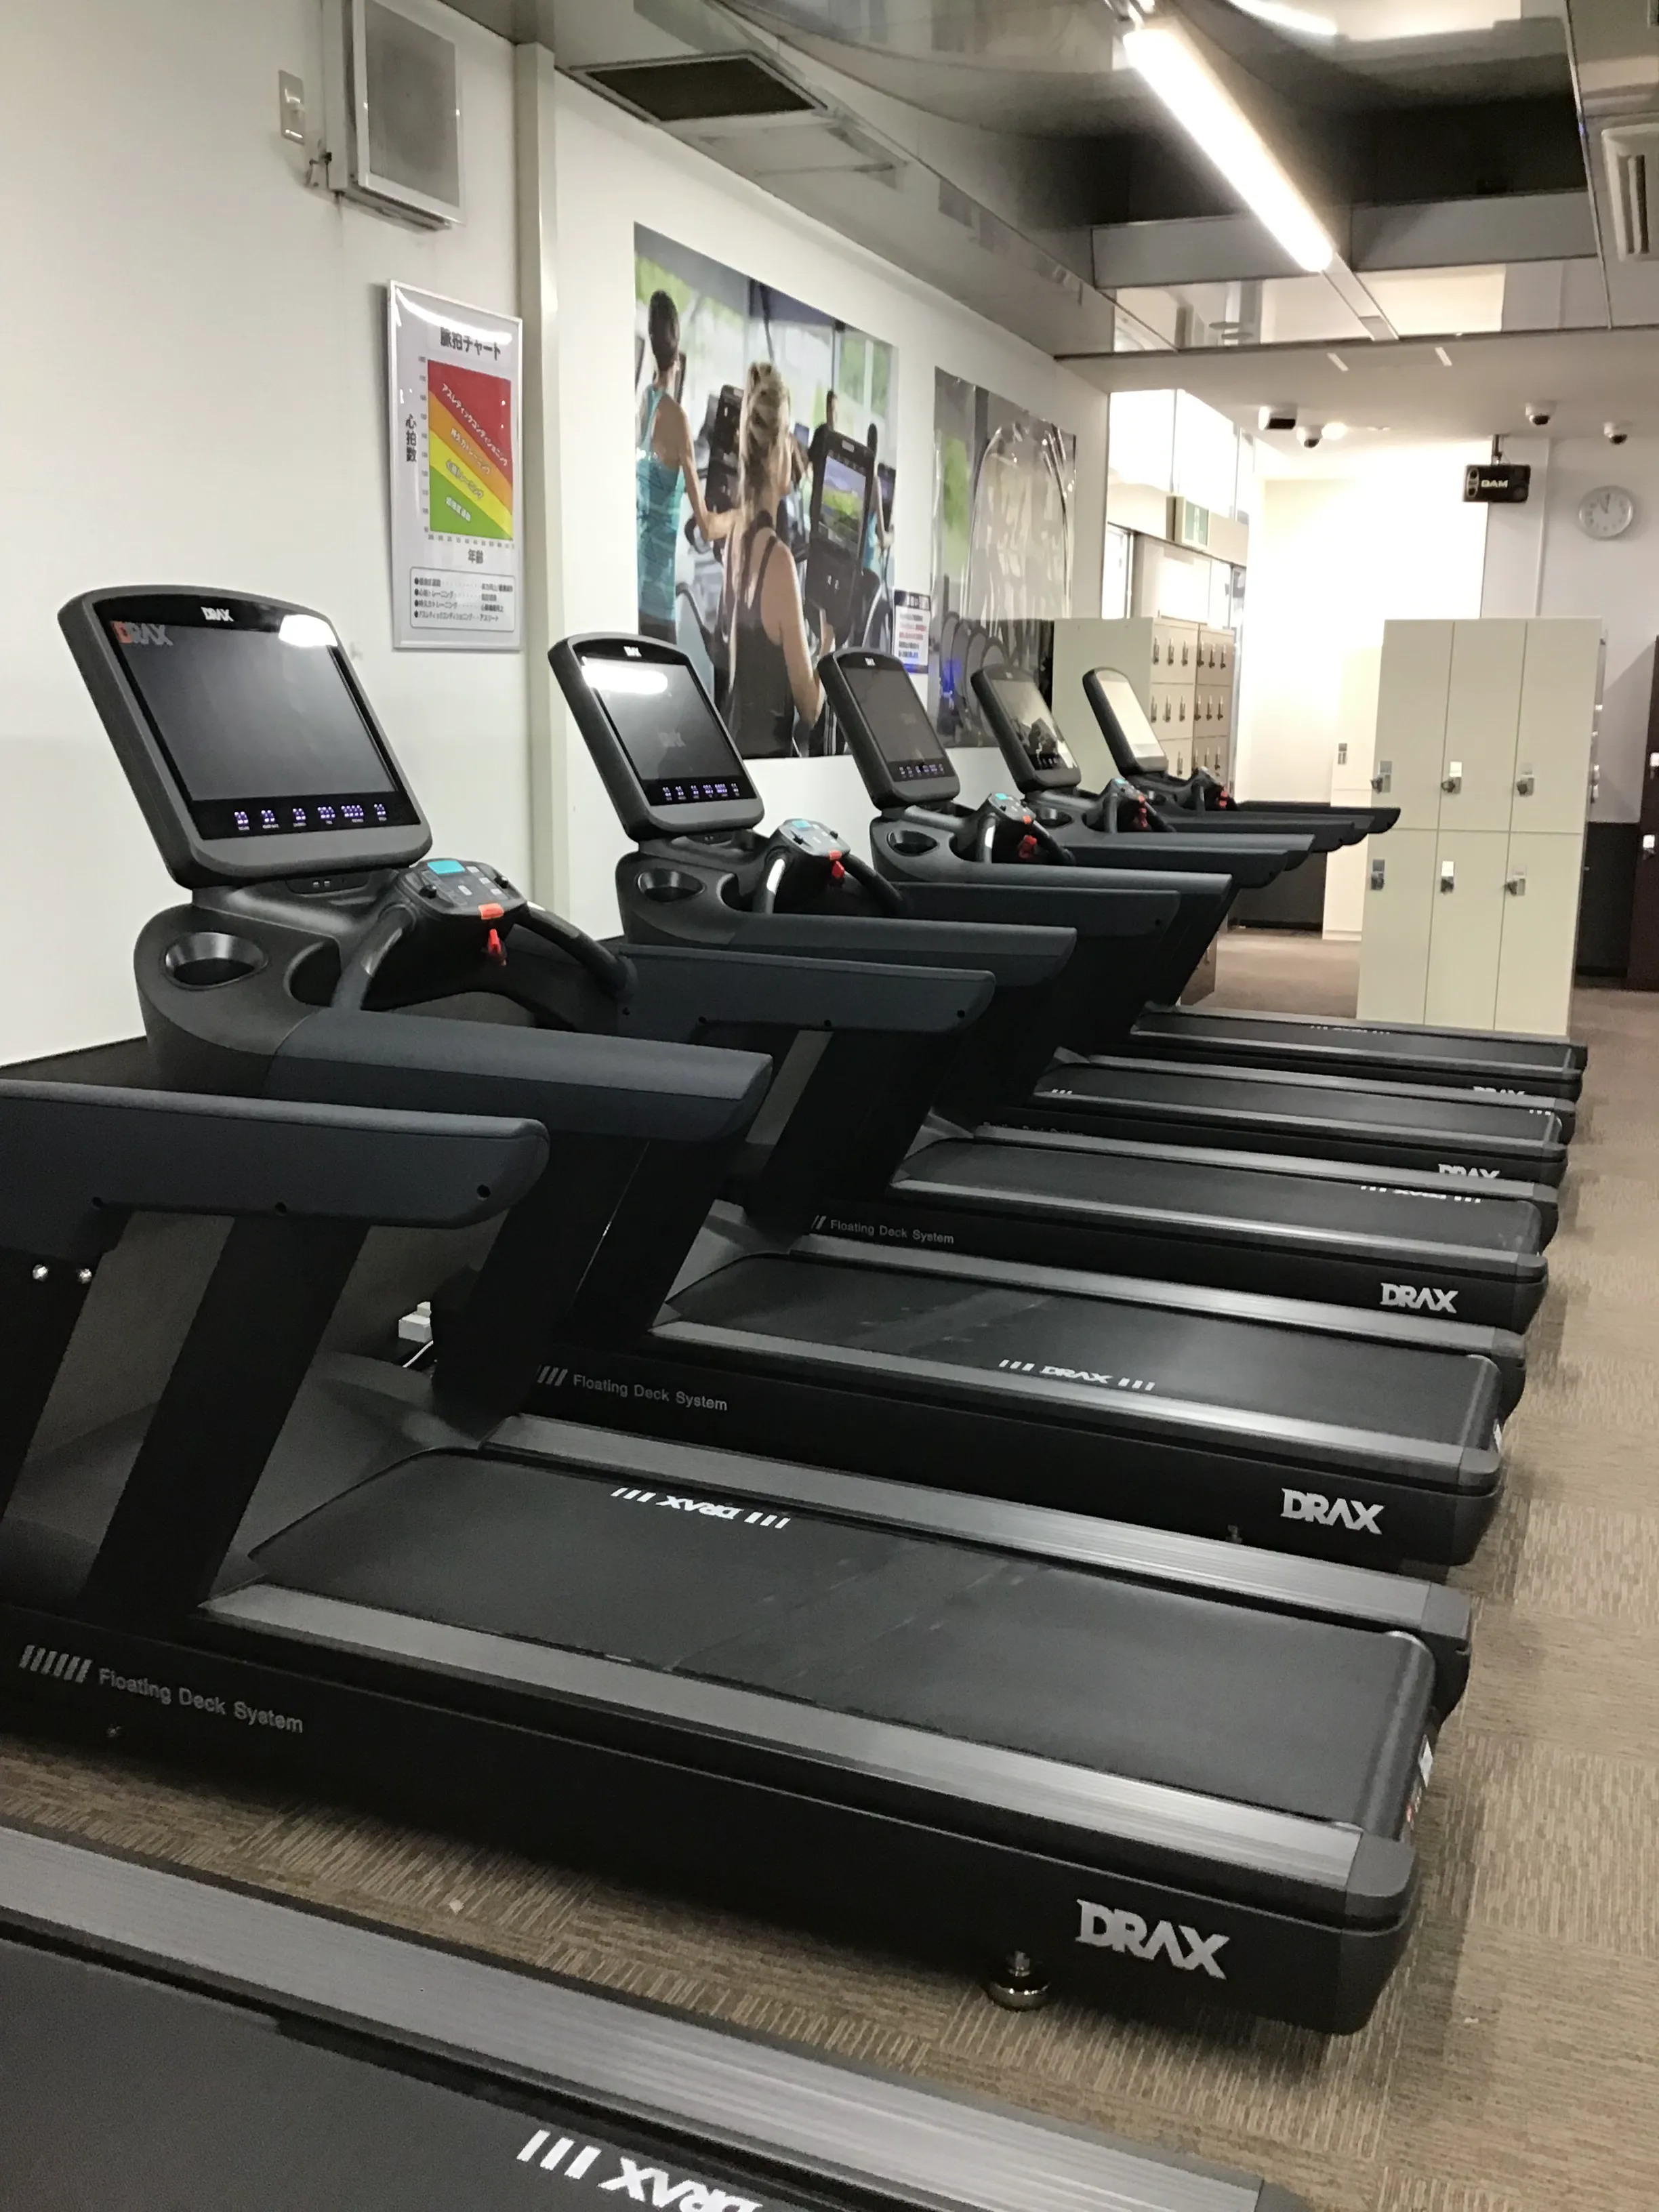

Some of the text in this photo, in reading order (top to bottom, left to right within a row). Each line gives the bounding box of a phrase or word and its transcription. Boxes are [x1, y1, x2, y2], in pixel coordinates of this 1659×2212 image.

[405, 413, 417, 463] 心拍数
[112, 620, 173, 644] DRAX
[830, 1219, 954, 1244] Floating Deck System
[1380, 1282, 1458, 1313] DRAX
[1039, 1365, 1114, 1385] DRAX
[573, 1374, 728, 1412] Floating Deck System
[655, 1494, 745, 1520] DRAX
[1280, 1488, 1385, 1535] DRAX
[98, 1667, 304, 1734] Floating Deck System
[1075, 1898, 1231, 1980] DRAX
